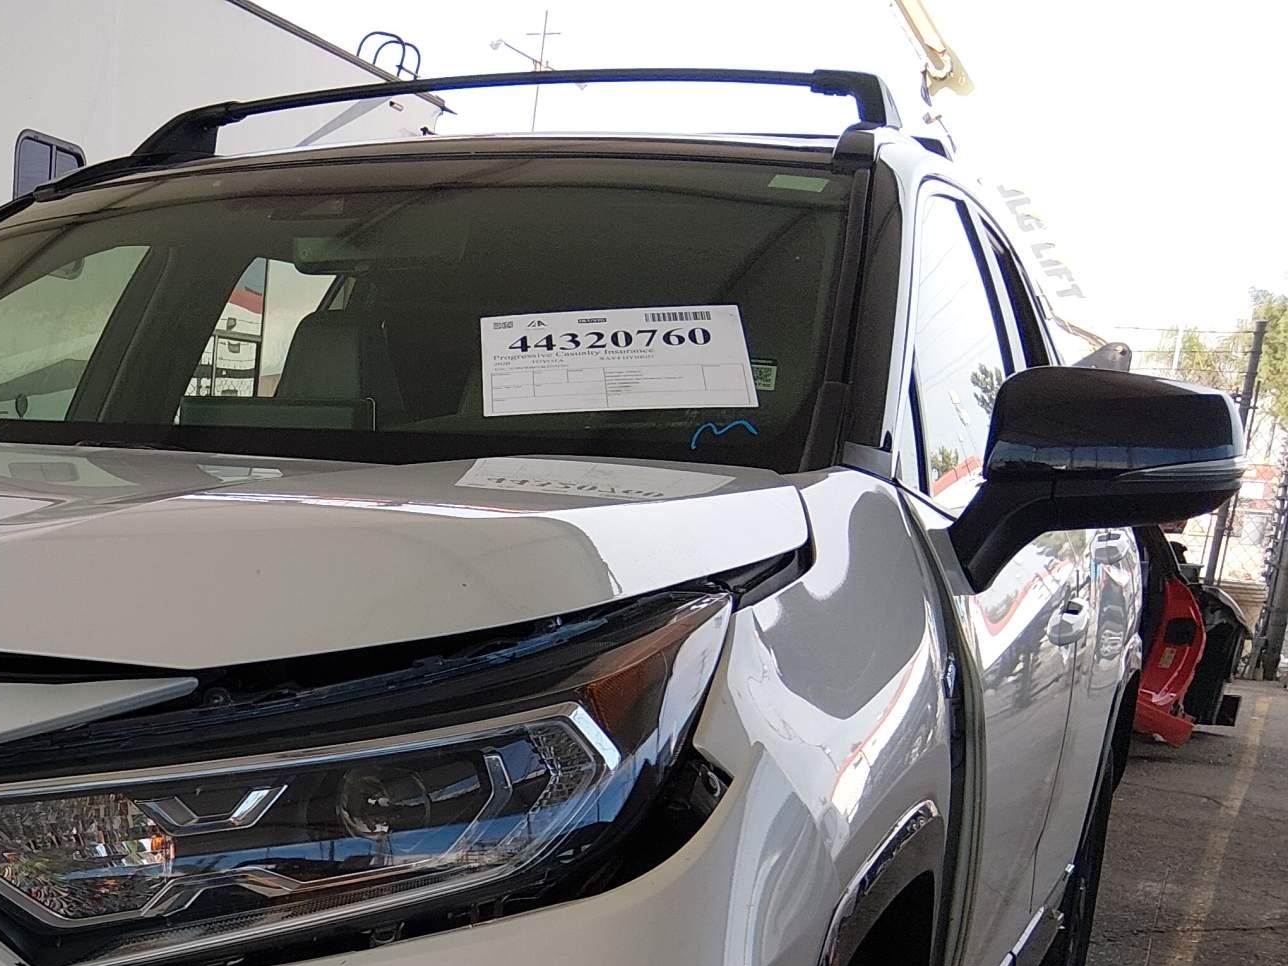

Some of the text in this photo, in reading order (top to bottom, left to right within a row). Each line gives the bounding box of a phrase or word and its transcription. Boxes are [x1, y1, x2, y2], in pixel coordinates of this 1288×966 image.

[1030, 242, 1087, 299] LIFT
[508, 327, 712, 353] 44320760
[493, 352, 553, 361] Progressive
